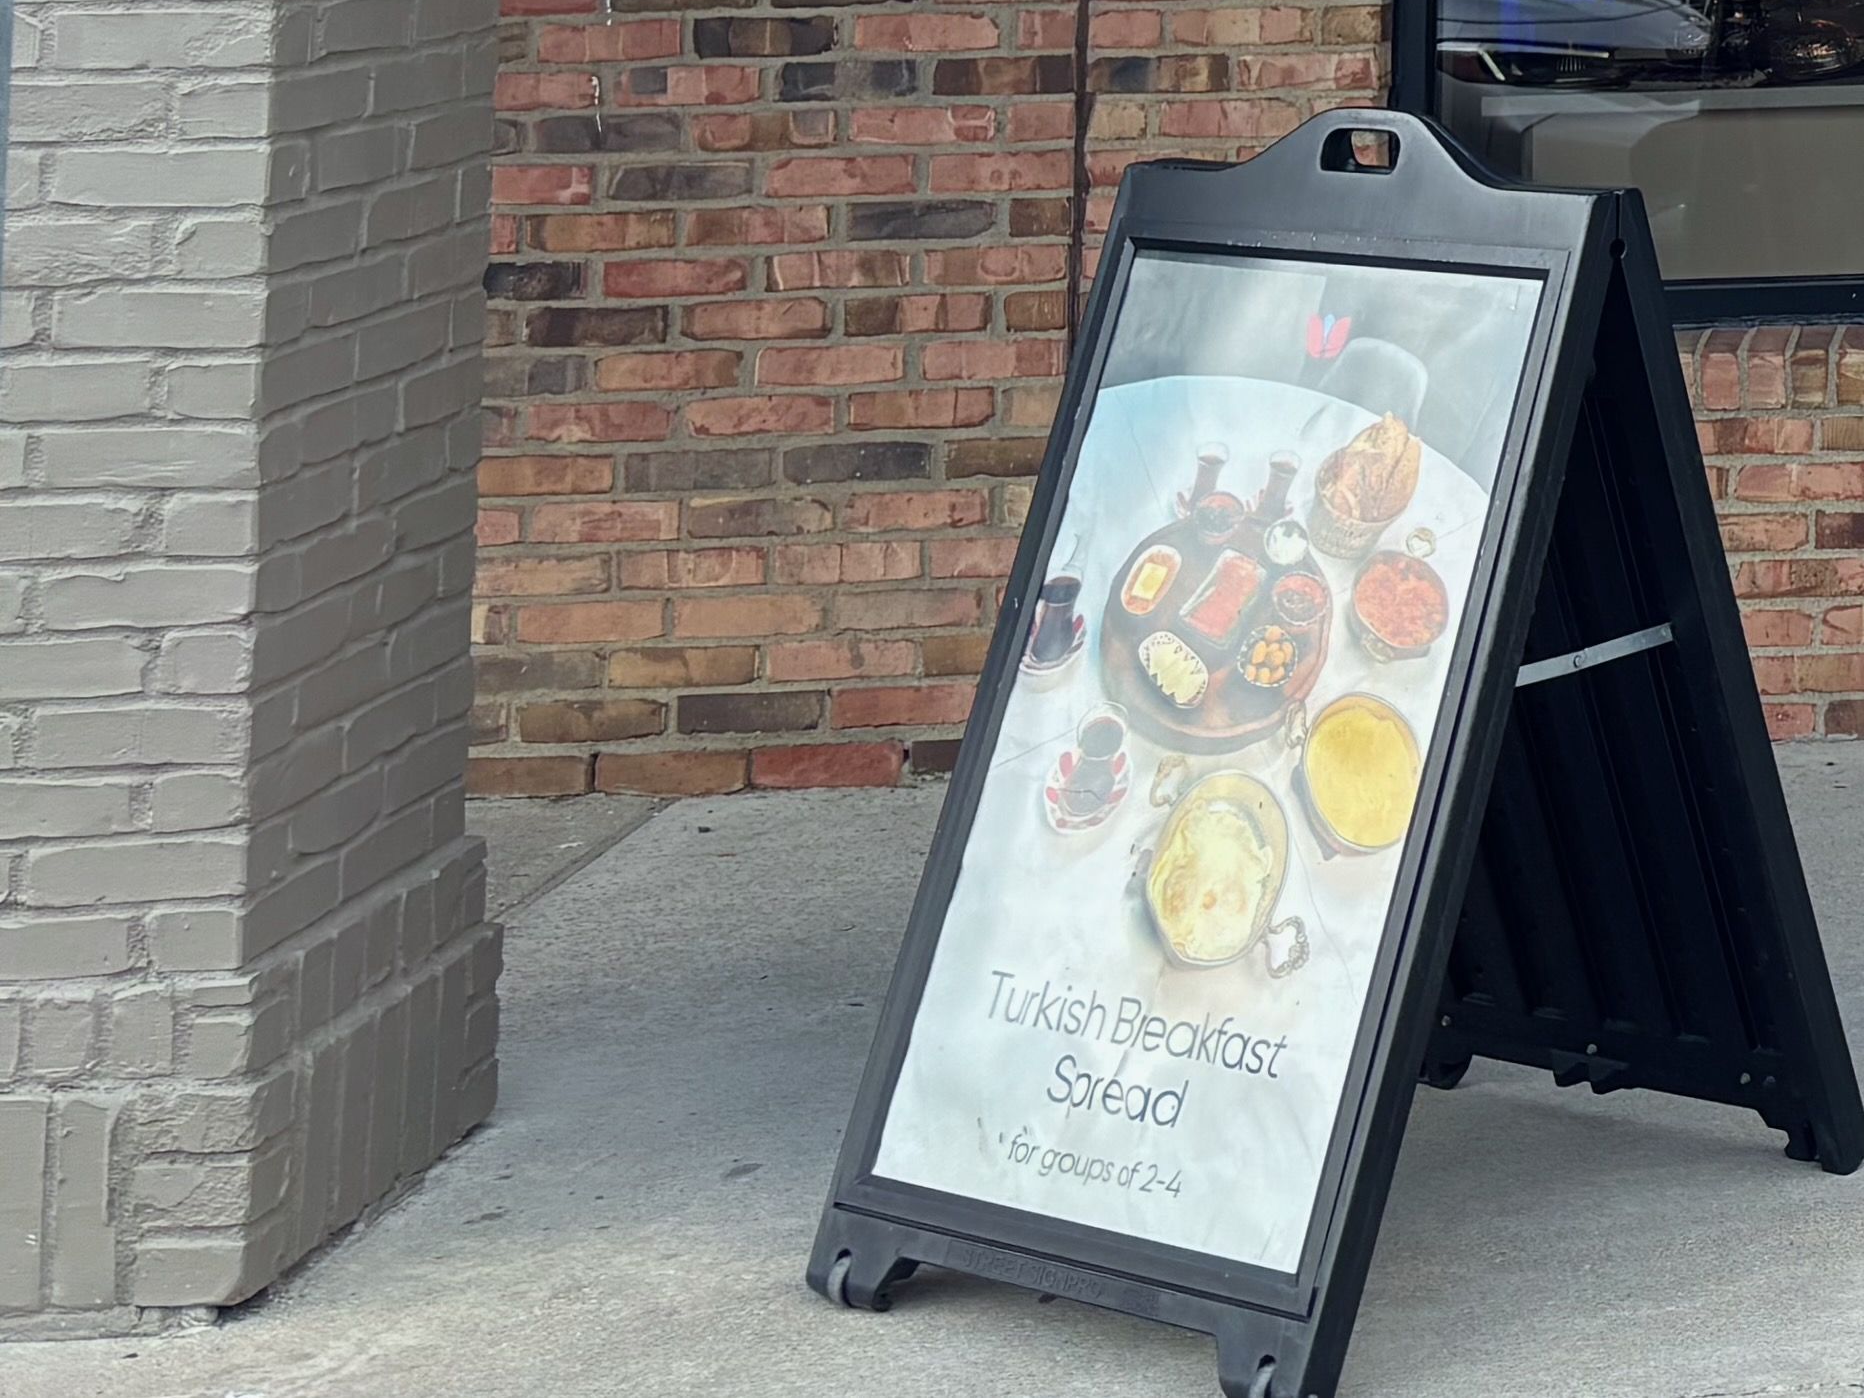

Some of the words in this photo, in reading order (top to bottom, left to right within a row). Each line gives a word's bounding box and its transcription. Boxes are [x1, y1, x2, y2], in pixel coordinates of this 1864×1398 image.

[988, 970, 1107, 1041] Turkish
[1046, 1054, 1190, 1128] Spread
[1007, 1133, 1041, 1164] for
[1117, 1160, 1142, 1189] of
[1139, 1164, 1183, 1198] 2-4
